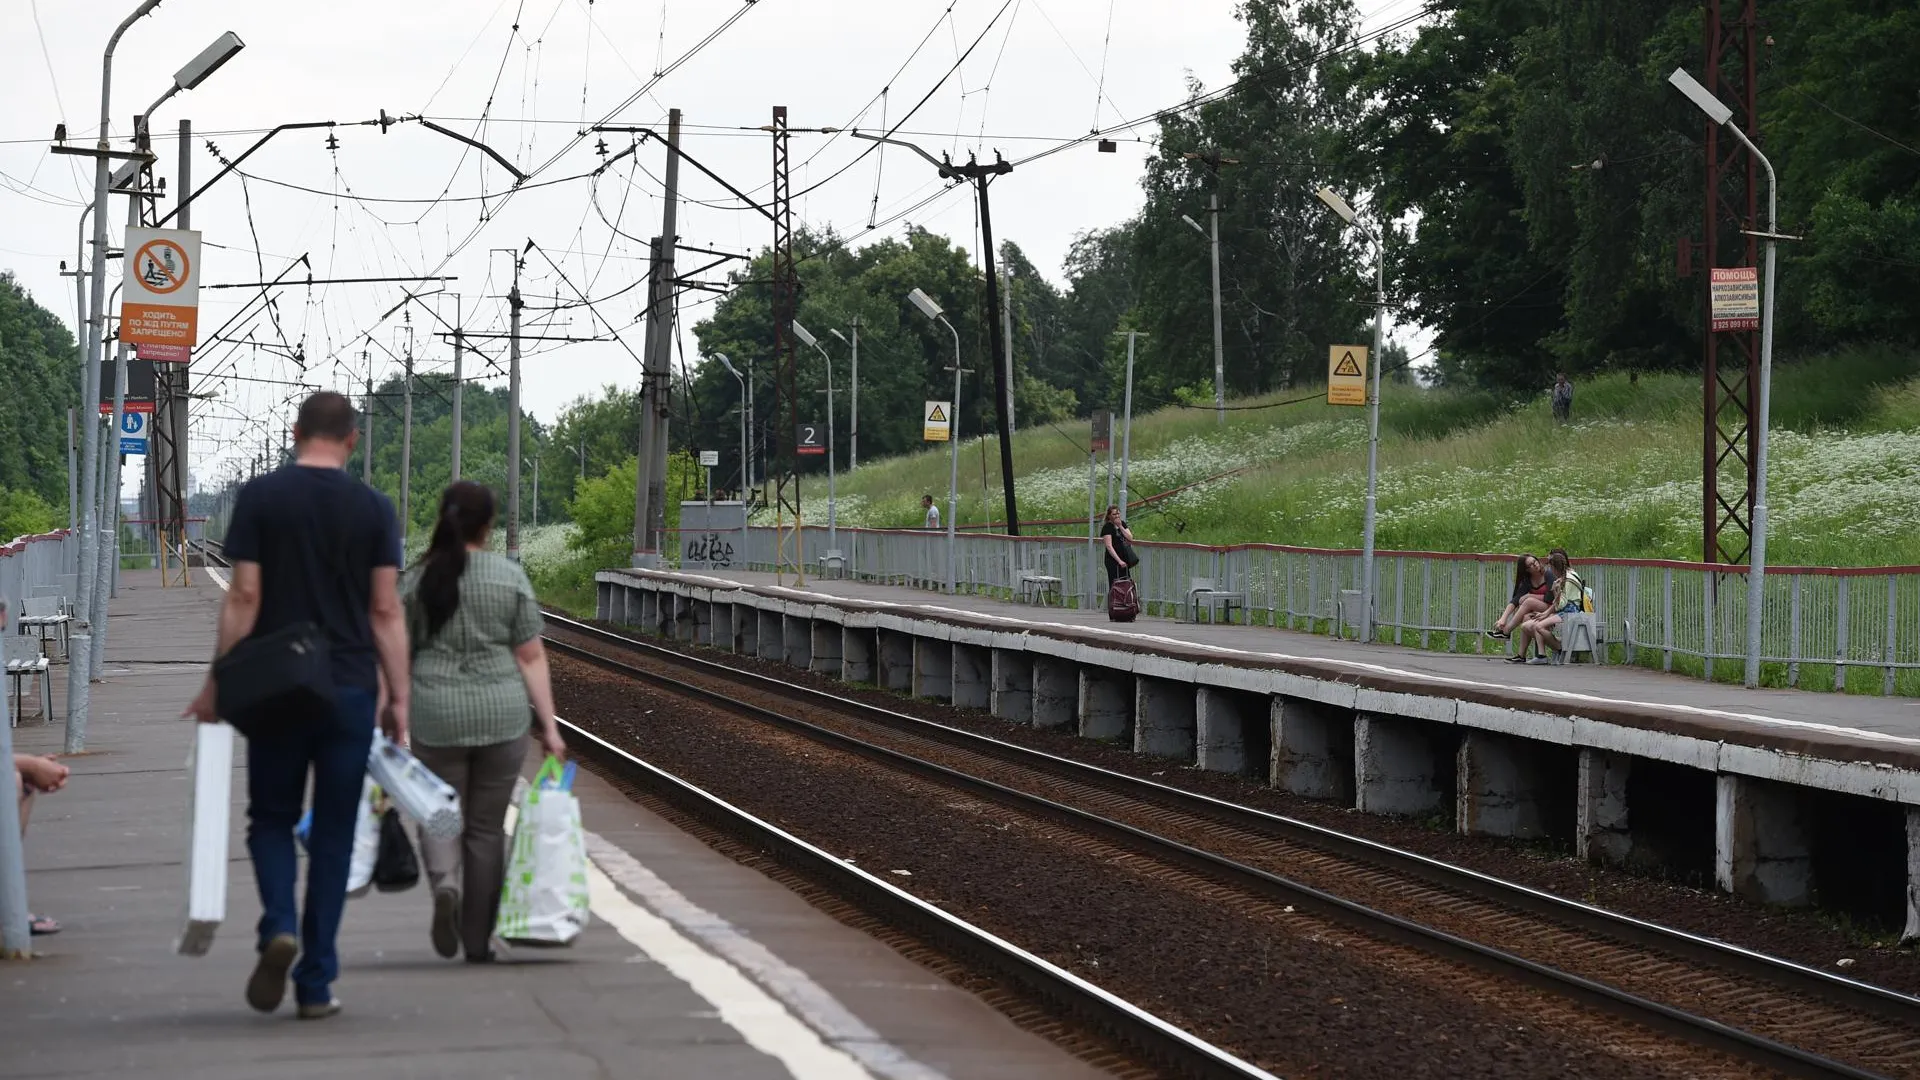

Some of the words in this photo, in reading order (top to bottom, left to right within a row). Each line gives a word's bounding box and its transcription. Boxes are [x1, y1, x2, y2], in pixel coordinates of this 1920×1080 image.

[1713, 270, 1756, 281] ПОМОЩЬ
[142, 310, 177, 320] ХОДИТЬ
[128, 318, 142, 326] ПО
[160, 320, 189, 329] ПУТЯМ
[131, 327, 187, 338] ЗАПРЕЩЕНО!
[804, 427, 816, 444] 2
